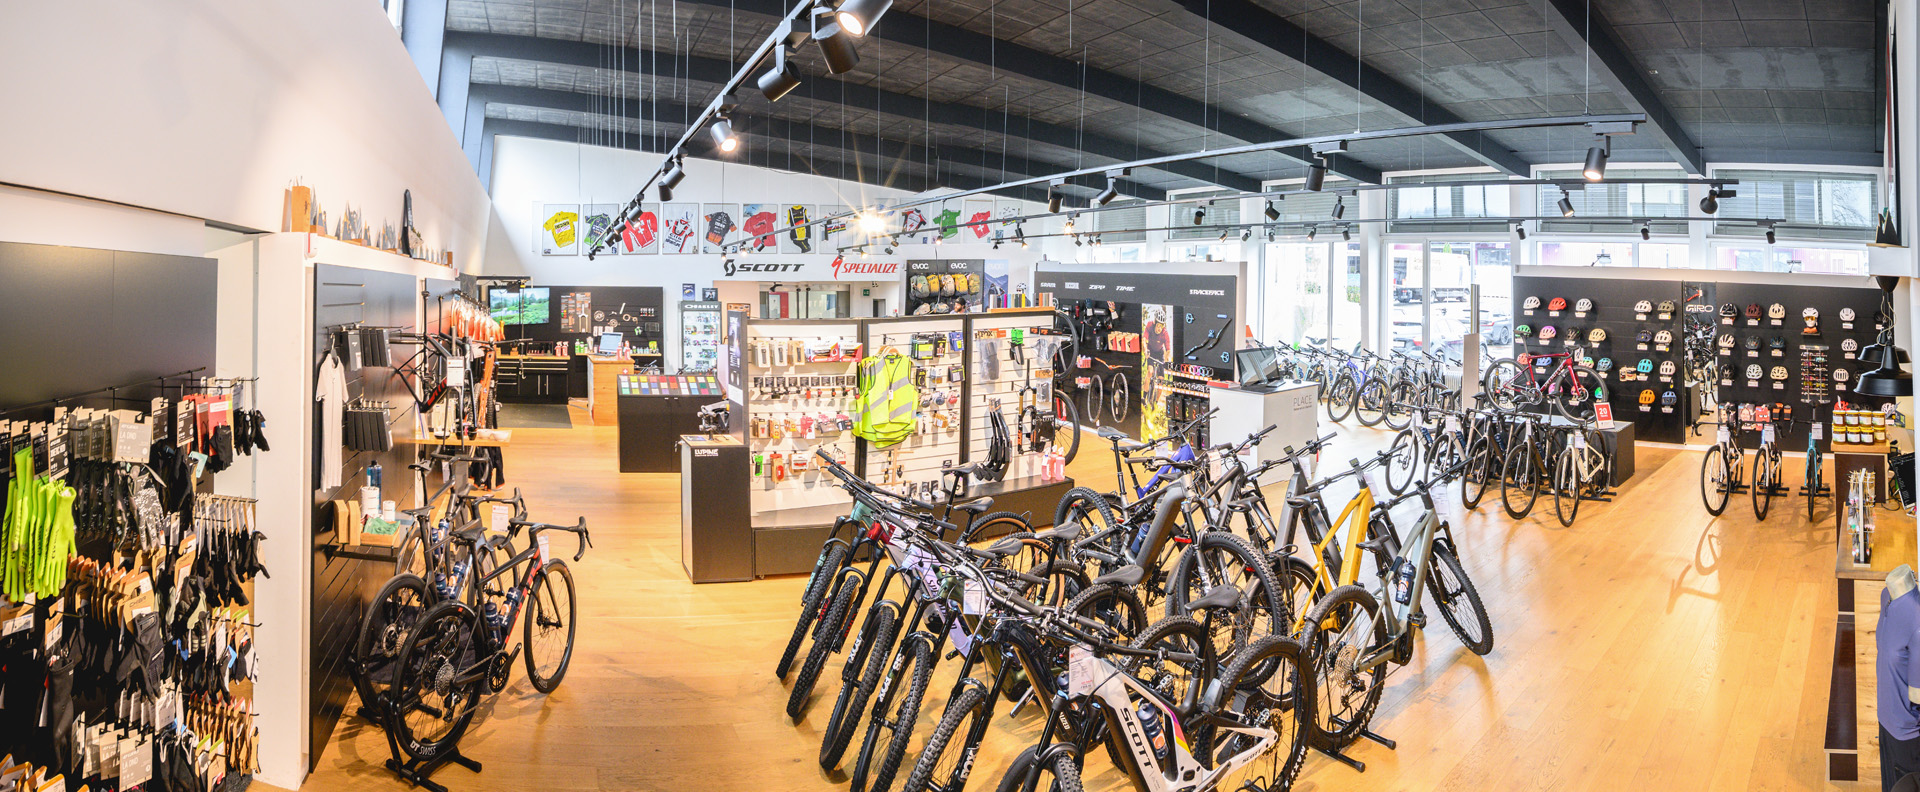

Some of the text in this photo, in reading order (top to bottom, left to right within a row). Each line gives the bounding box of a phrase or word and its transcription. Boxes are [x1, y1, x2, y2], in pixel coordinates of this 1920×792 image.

[737, 263, 805, 272] SCOTT
[1685, 304, 1714, 313] GIRO
[1293, 394, 1313, 407] PLACE
[1598, 407, 1608, 415] 20
[1119, 706, 1154, 769] SCOTT
[409, 739, 437, 756] DT SWISS
[960, 749, 979, 780] FOX
[1284, 745, 1306, 788] MAXXS
